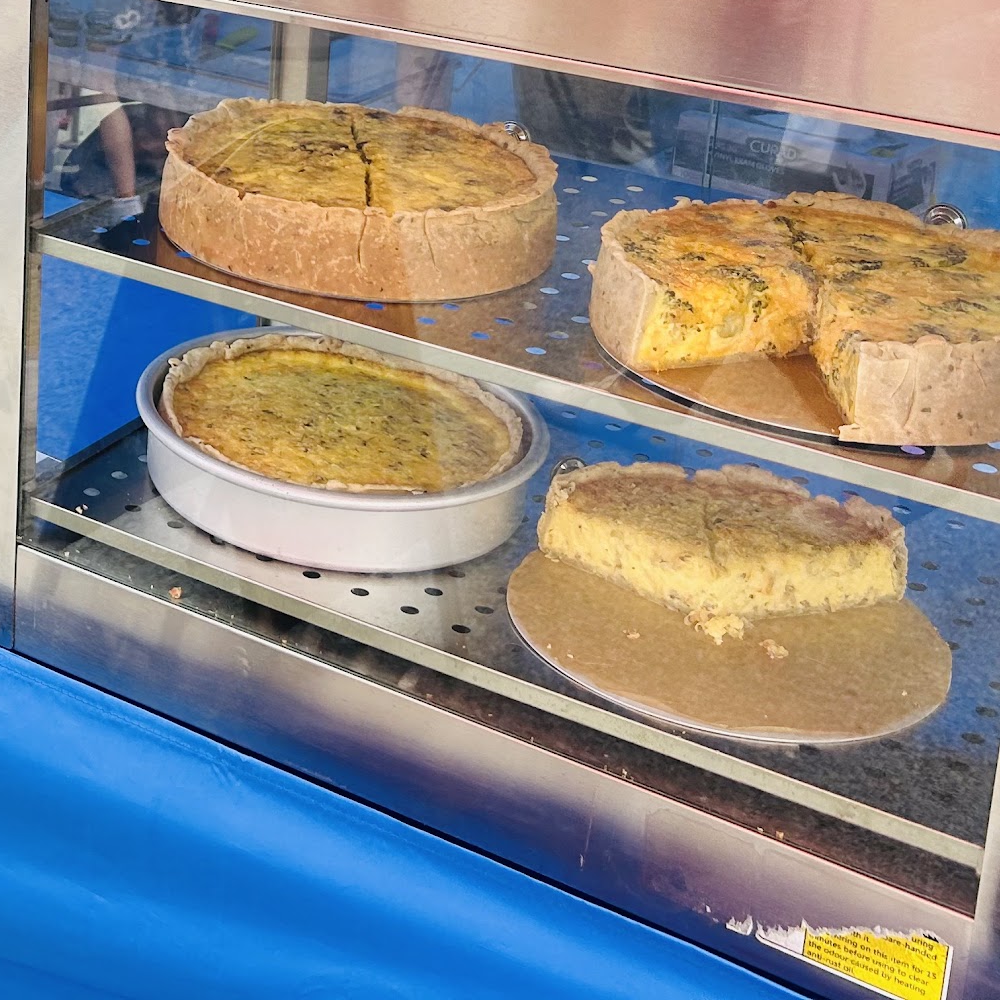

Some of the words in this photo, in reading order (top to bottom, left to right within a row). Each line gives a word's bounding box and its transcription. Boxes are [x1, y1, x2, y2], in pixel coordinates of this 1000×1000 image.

[807, 950, 842, 968] anti-rust
[911, 936, 934, 951] uring
[808, 940, 822, 951] the
[824, 948, 850, 962] odour
[850, 960, 880, 975] caused
[881, 970, 892, 981] by
[894, 976, 926, 996] heating
[844, 945, 871, 961] before
[873, 959, 895, 973] using
[898, 968, 907, 977] to
[909, 974, 929, 987] clear
[860, 944, 871, 952] on
[873, 949, 888, 960] this
[891, 957, 910, 968] item
[912, 965, 924, 974] for
[927, 970, 937, 980] 15
